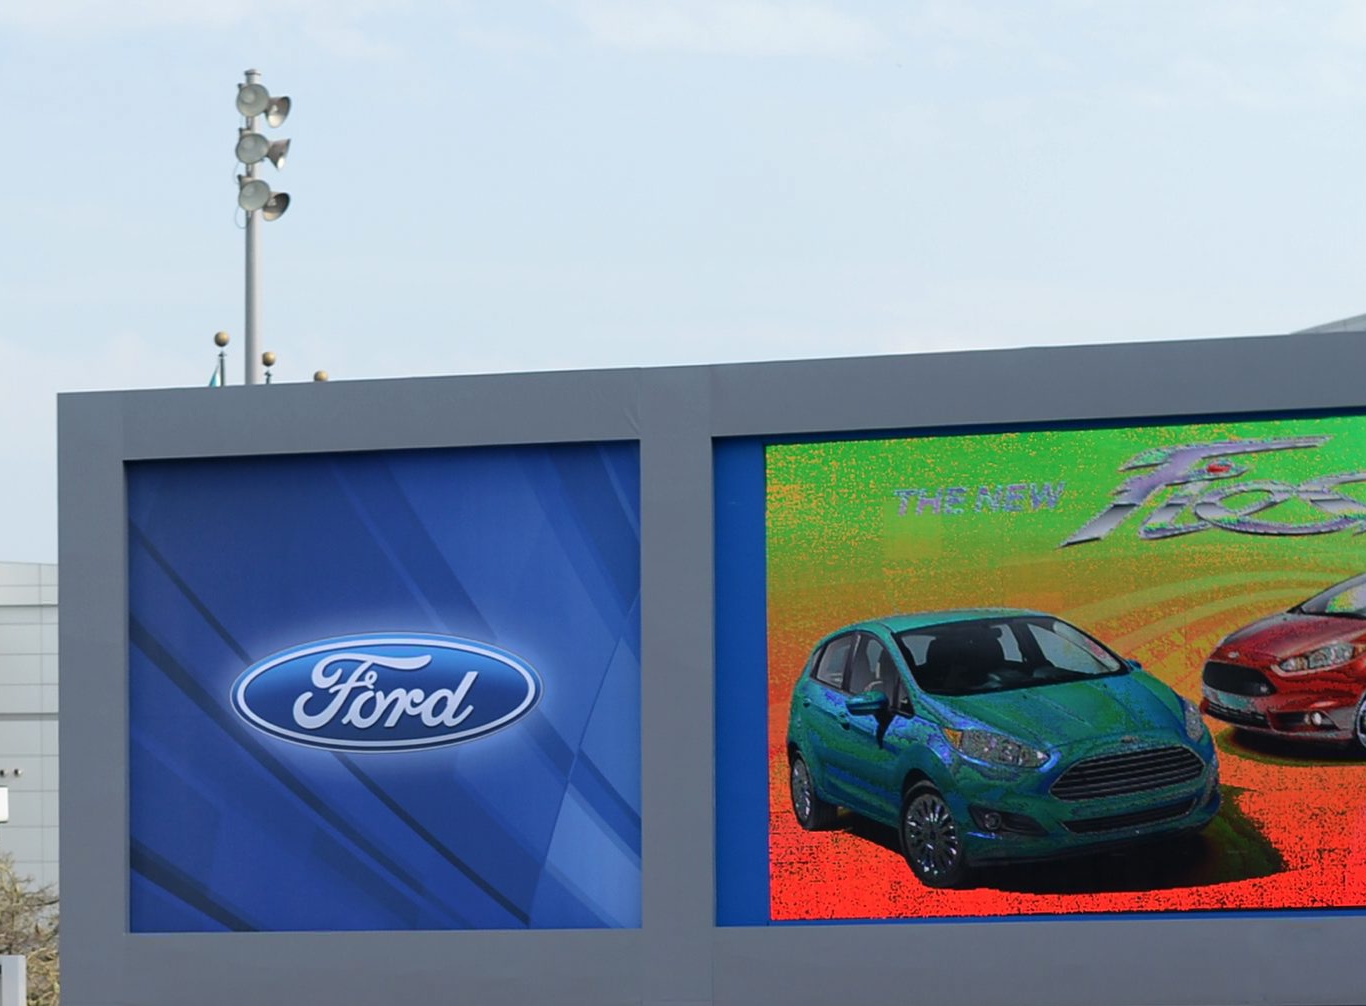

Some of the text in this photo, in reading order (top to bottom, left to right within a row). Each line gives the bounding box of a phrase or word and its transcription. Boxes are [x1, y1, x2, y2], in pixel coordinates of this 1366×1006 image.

[894, 481, 1067, 518] THE NEW
[293, 653, 478, 729] Ford
